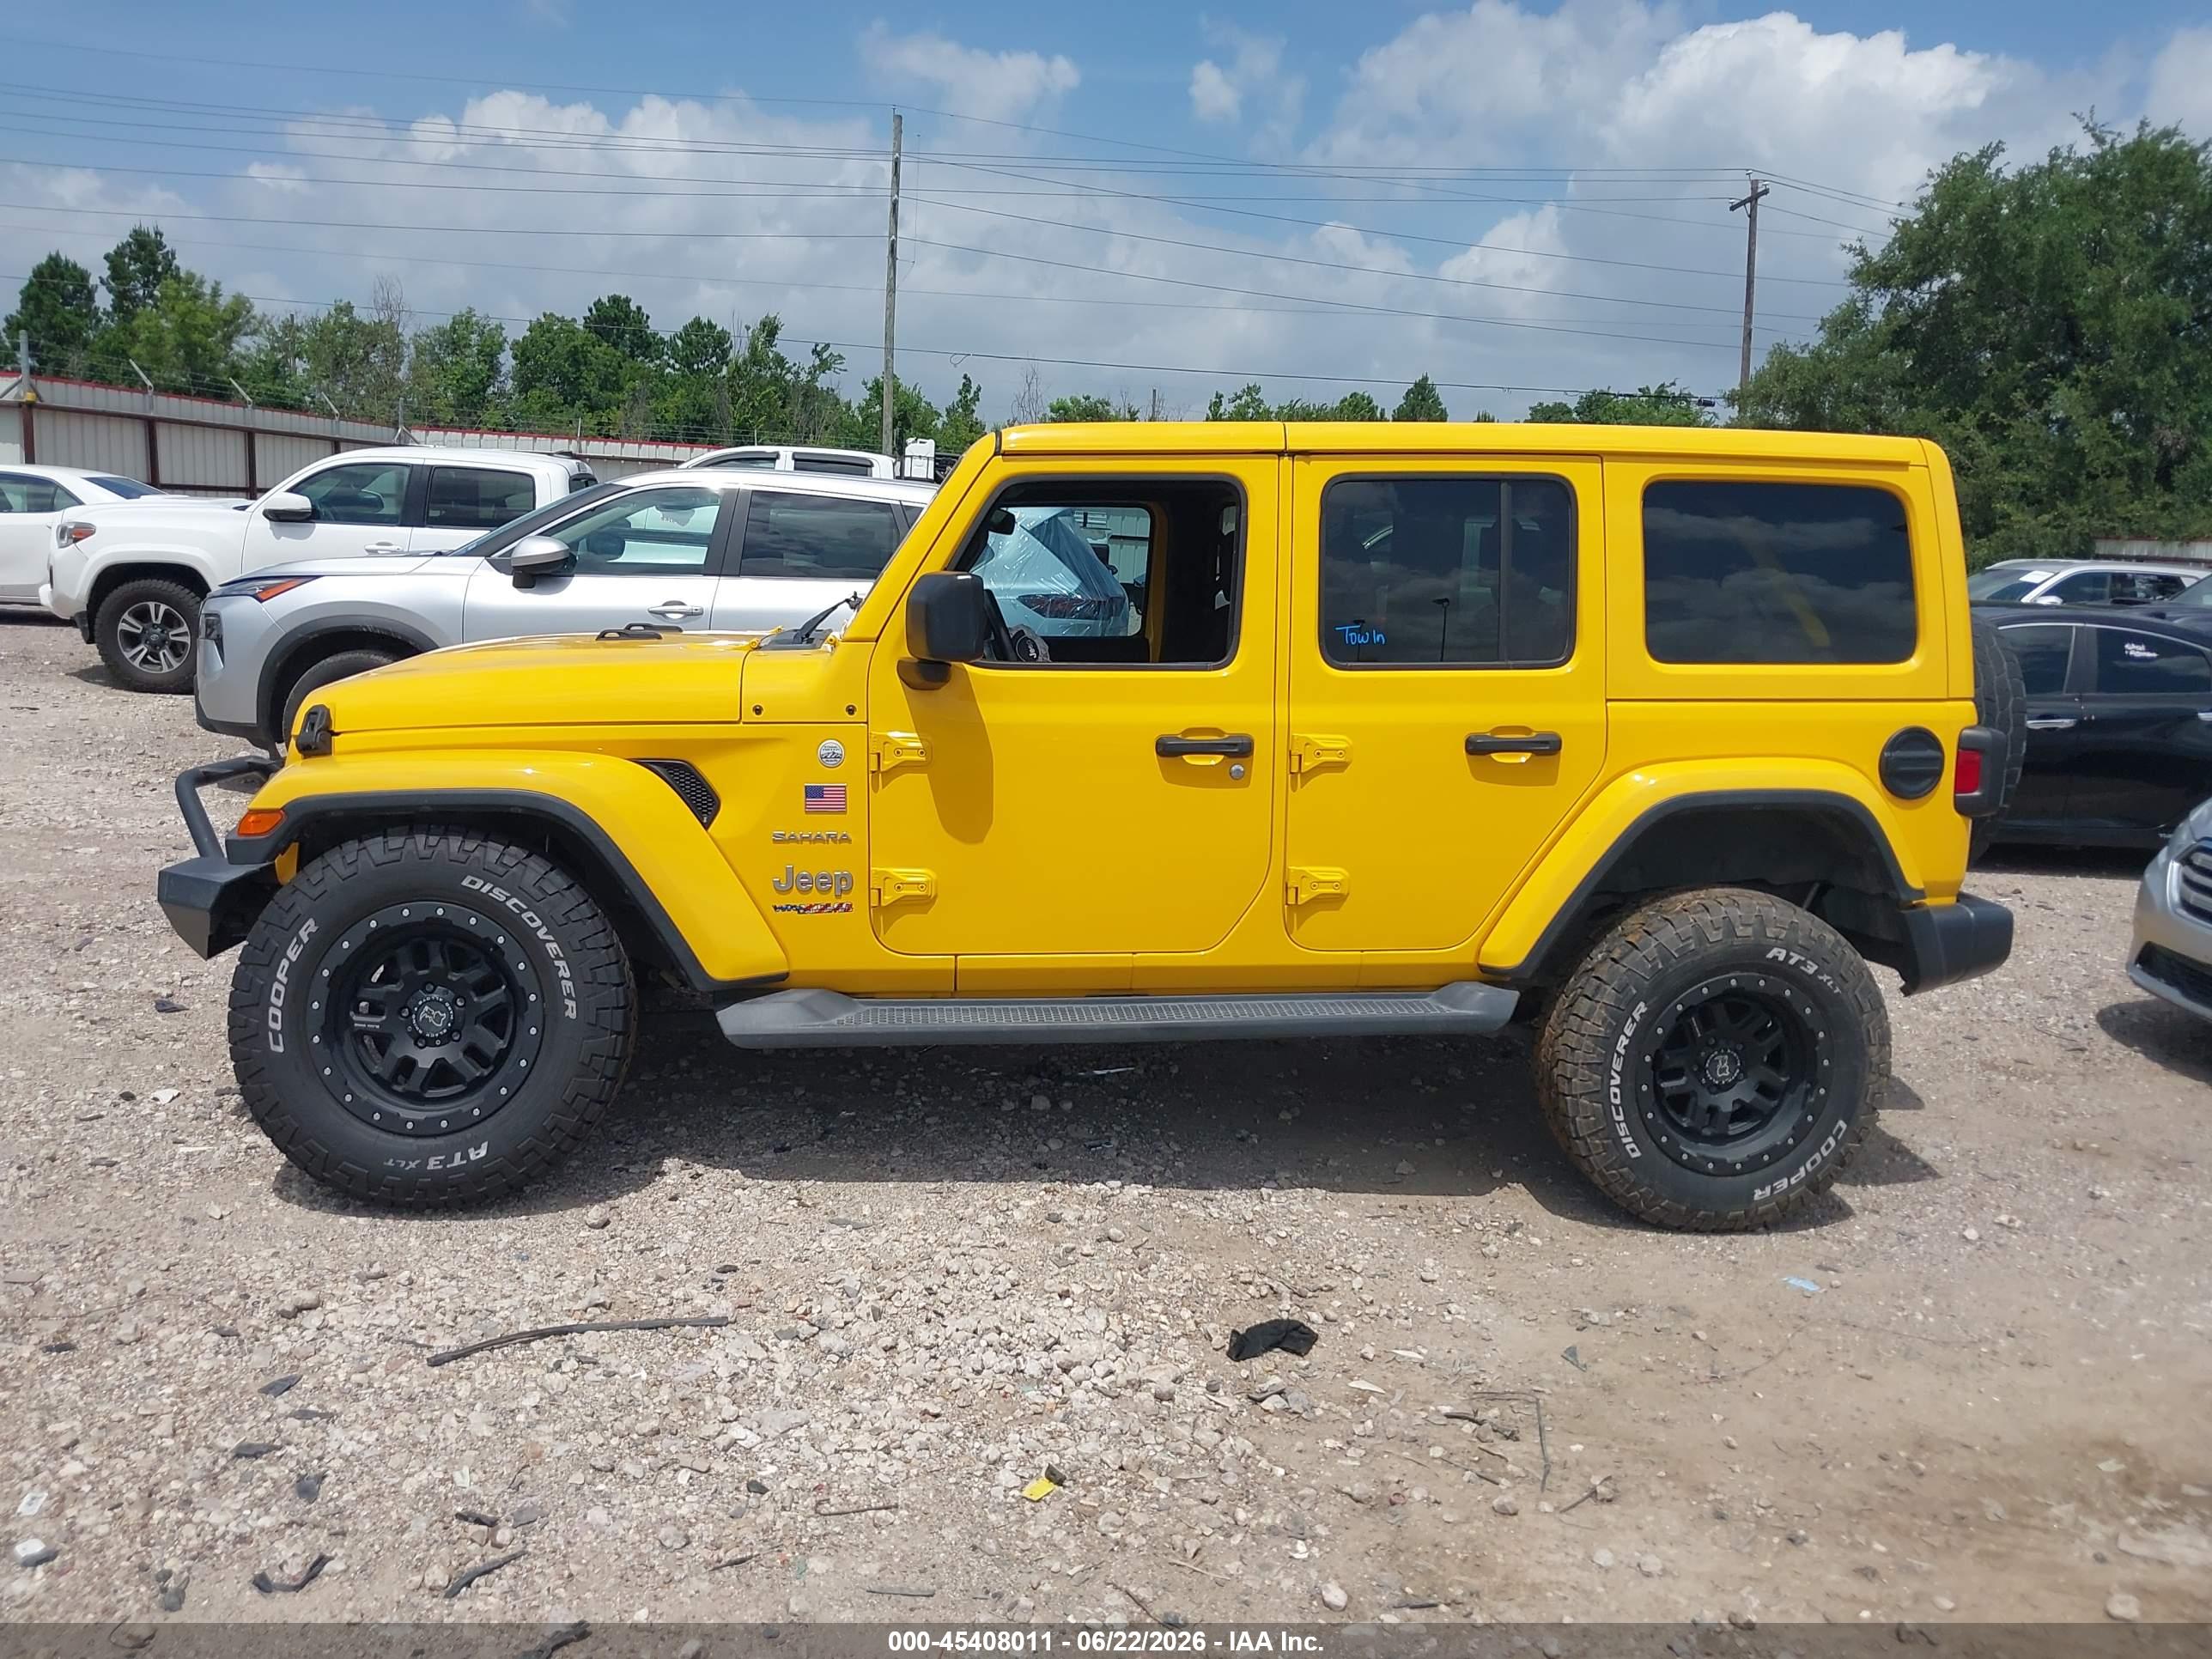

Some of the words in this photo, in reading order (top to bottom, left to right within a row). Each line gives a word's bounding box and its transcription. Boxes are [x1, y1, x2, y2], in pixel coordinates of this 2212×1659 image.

[1334, 624, 1370, 646] Tow
[1372, 629, 1386, 646] In
[772, 830, 853, 845] SAHARA
[772, 864, 854, 897] Jeep
[460, 873, 578, 1020] DISCOVERER
[1765, 946, 1820, 975] AT3
[1816, 973, 1842, 994] XLT
[267, 916, 319, 1054] COOPER
[1608, 1000, 1648, 1159] DISCOVERER
[426, 1140, 489, 1170] AT3
[1753, 1119, 1848, 1202] COOPER
